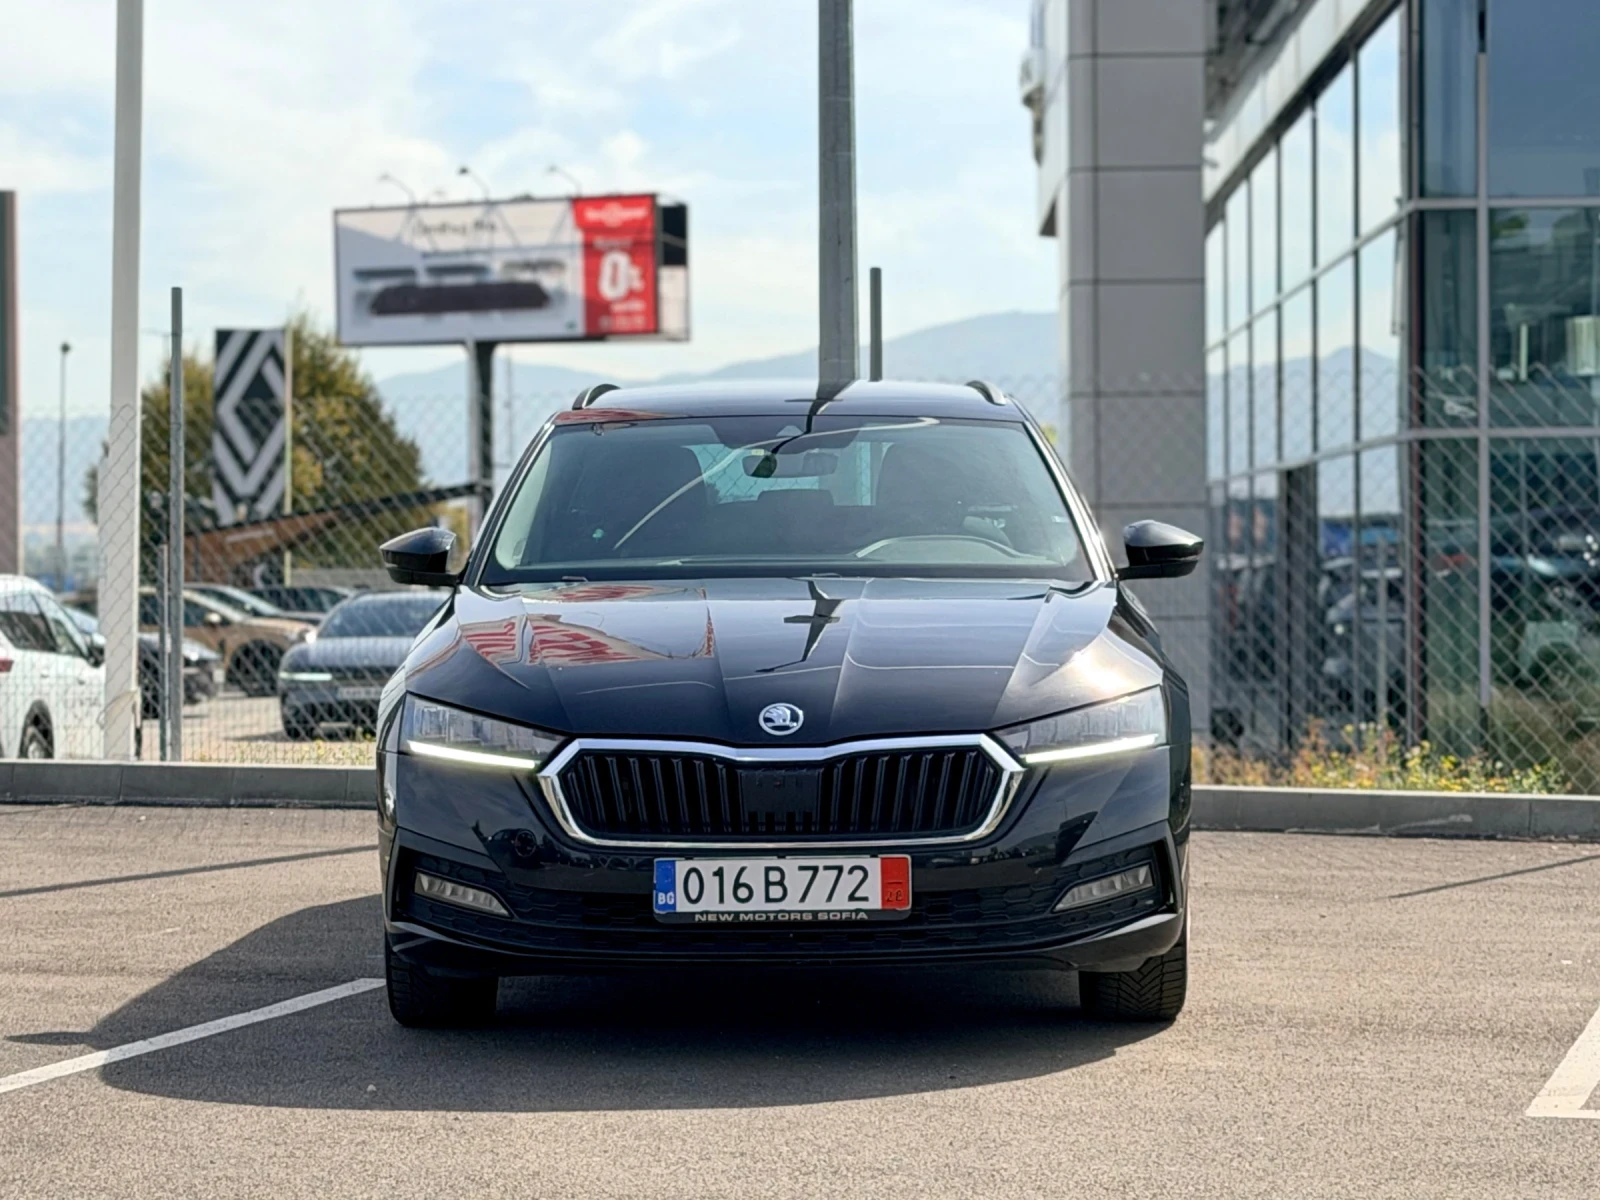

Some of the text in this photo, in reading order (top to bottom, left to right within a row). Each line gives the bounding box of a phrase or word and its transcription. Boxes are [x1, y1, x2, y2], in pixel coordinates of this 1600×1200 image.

[683, 865, 869, 905] 016B772
[657, 891, 675, 905] BG
[694, 911, 868, 922] NEW MOTORS SOFIA
